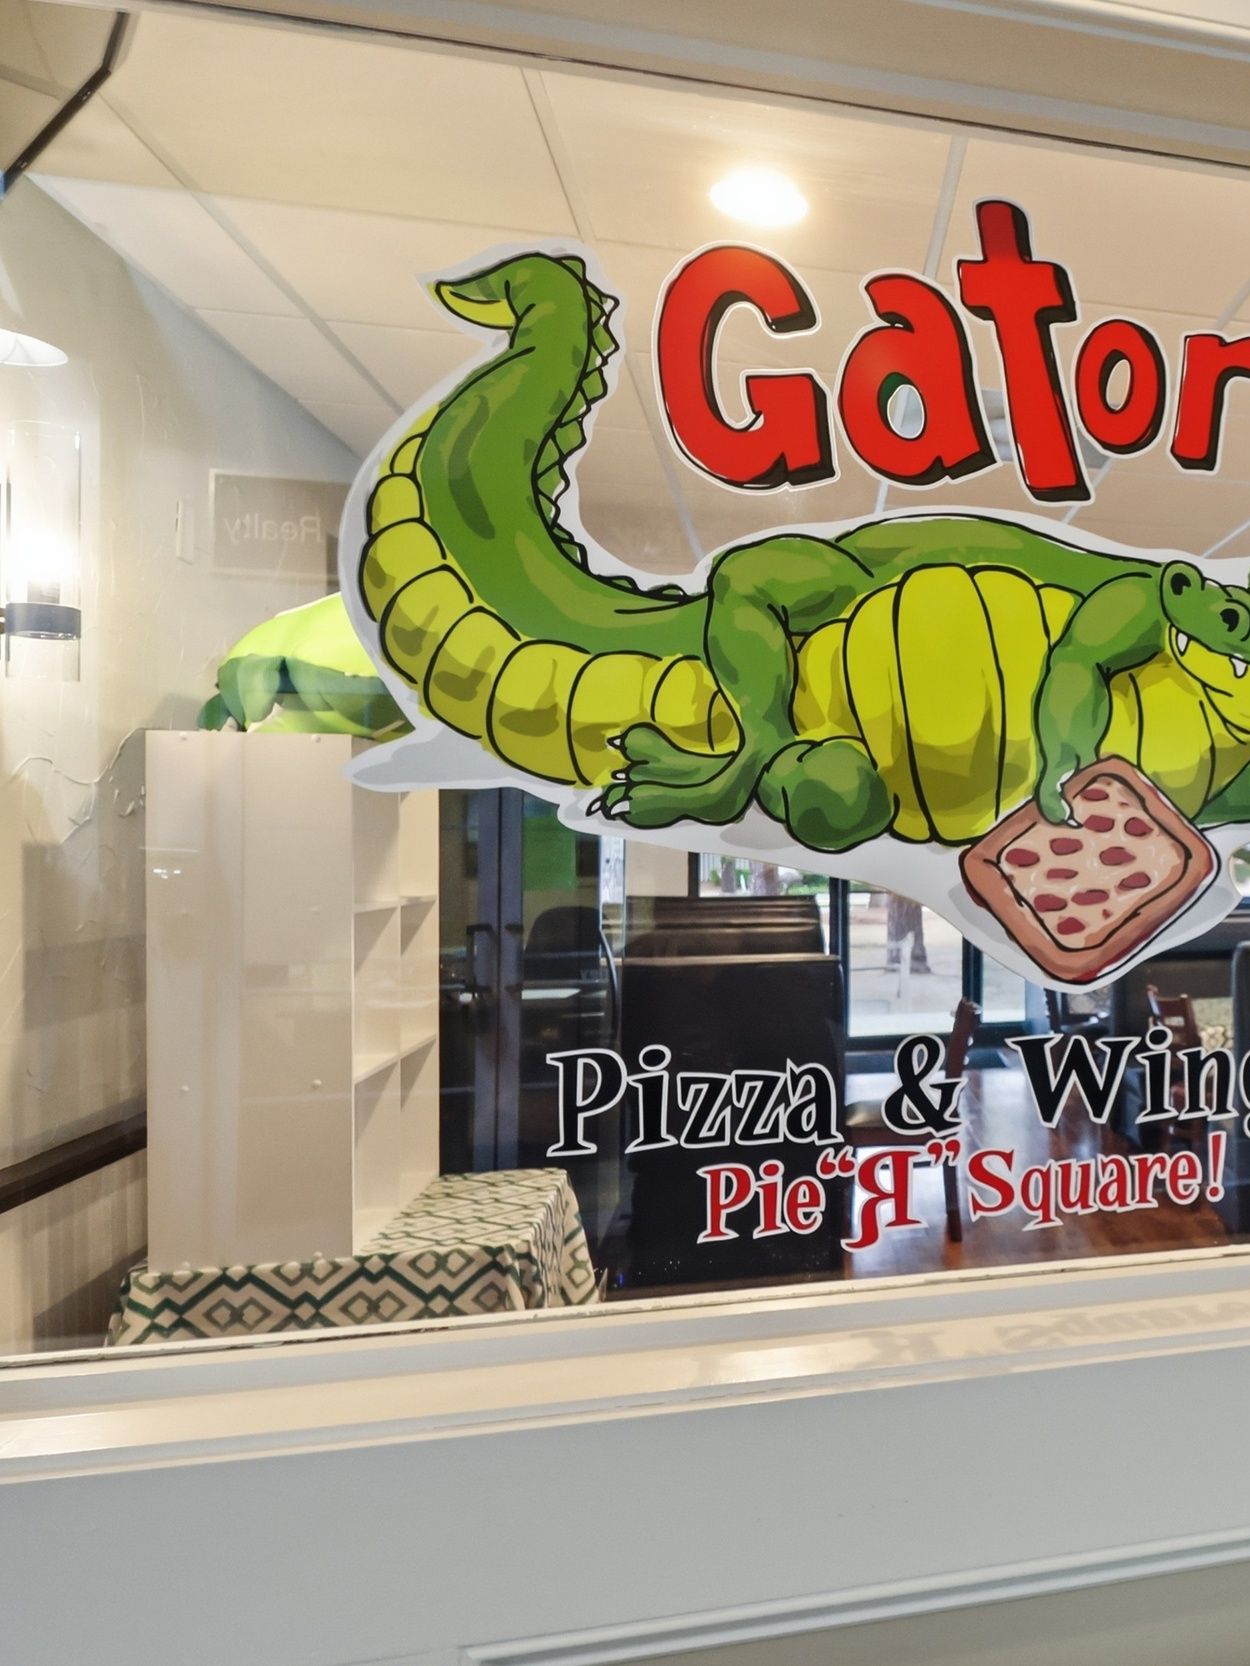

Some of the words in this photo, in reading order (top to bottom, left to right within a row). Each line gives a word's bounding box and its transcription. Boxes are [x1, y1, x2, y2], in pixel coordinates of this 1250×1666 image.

[546, 1044, 845, 1157] Pizza
[881, 1034, 968, 1137] &
[965, 1133, 1227, 1232] Square!
